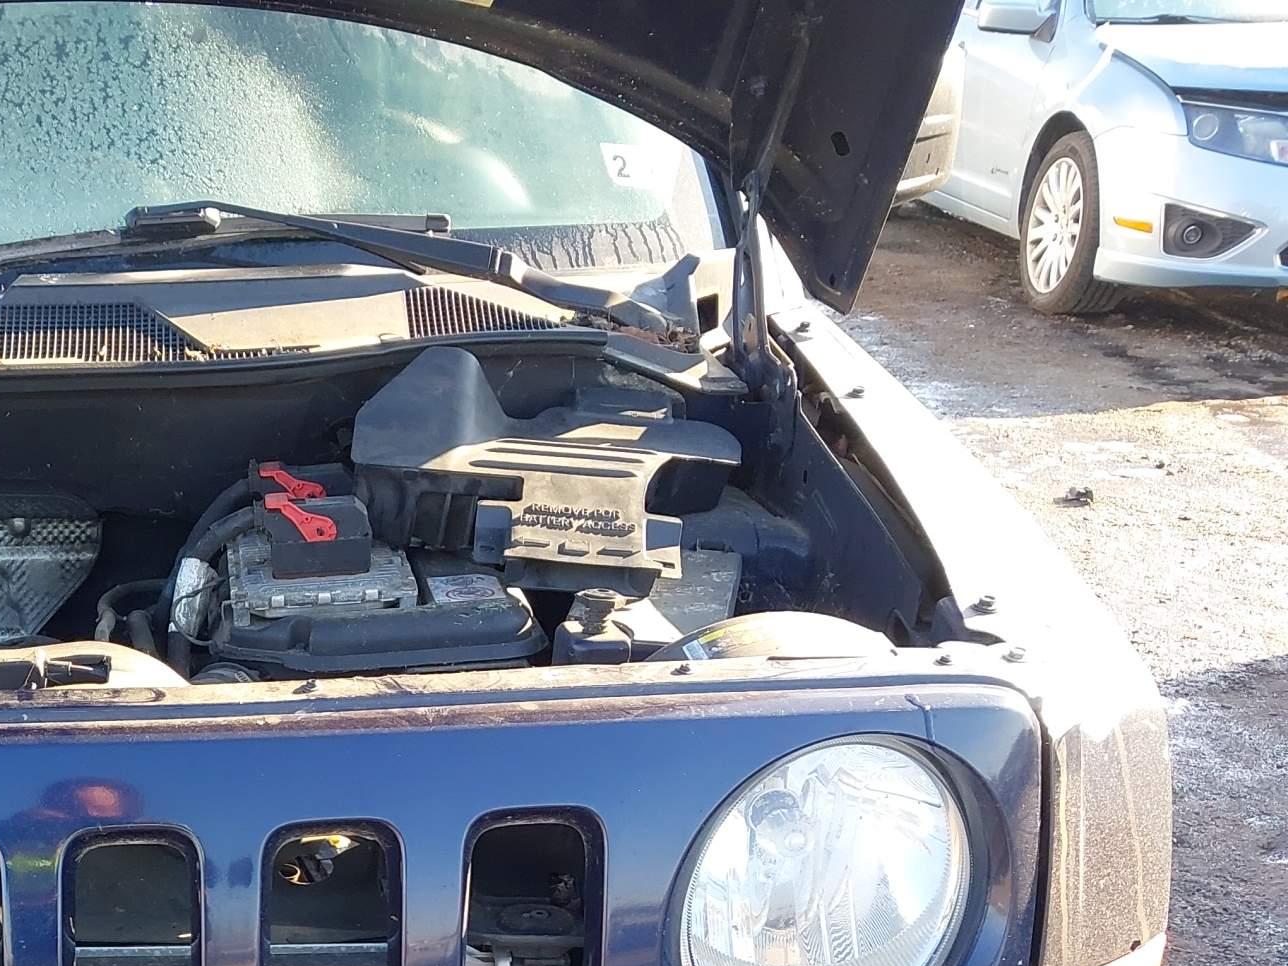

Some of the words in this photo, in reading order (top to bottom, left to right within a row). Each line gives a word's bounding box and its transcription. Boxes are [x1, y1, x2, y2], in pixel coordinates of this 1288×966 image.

[530, 502, 589, 518] REMOVE
[520, 513, 584, 530] BATTERY
[582, 519, 637, 532] ACCESS
